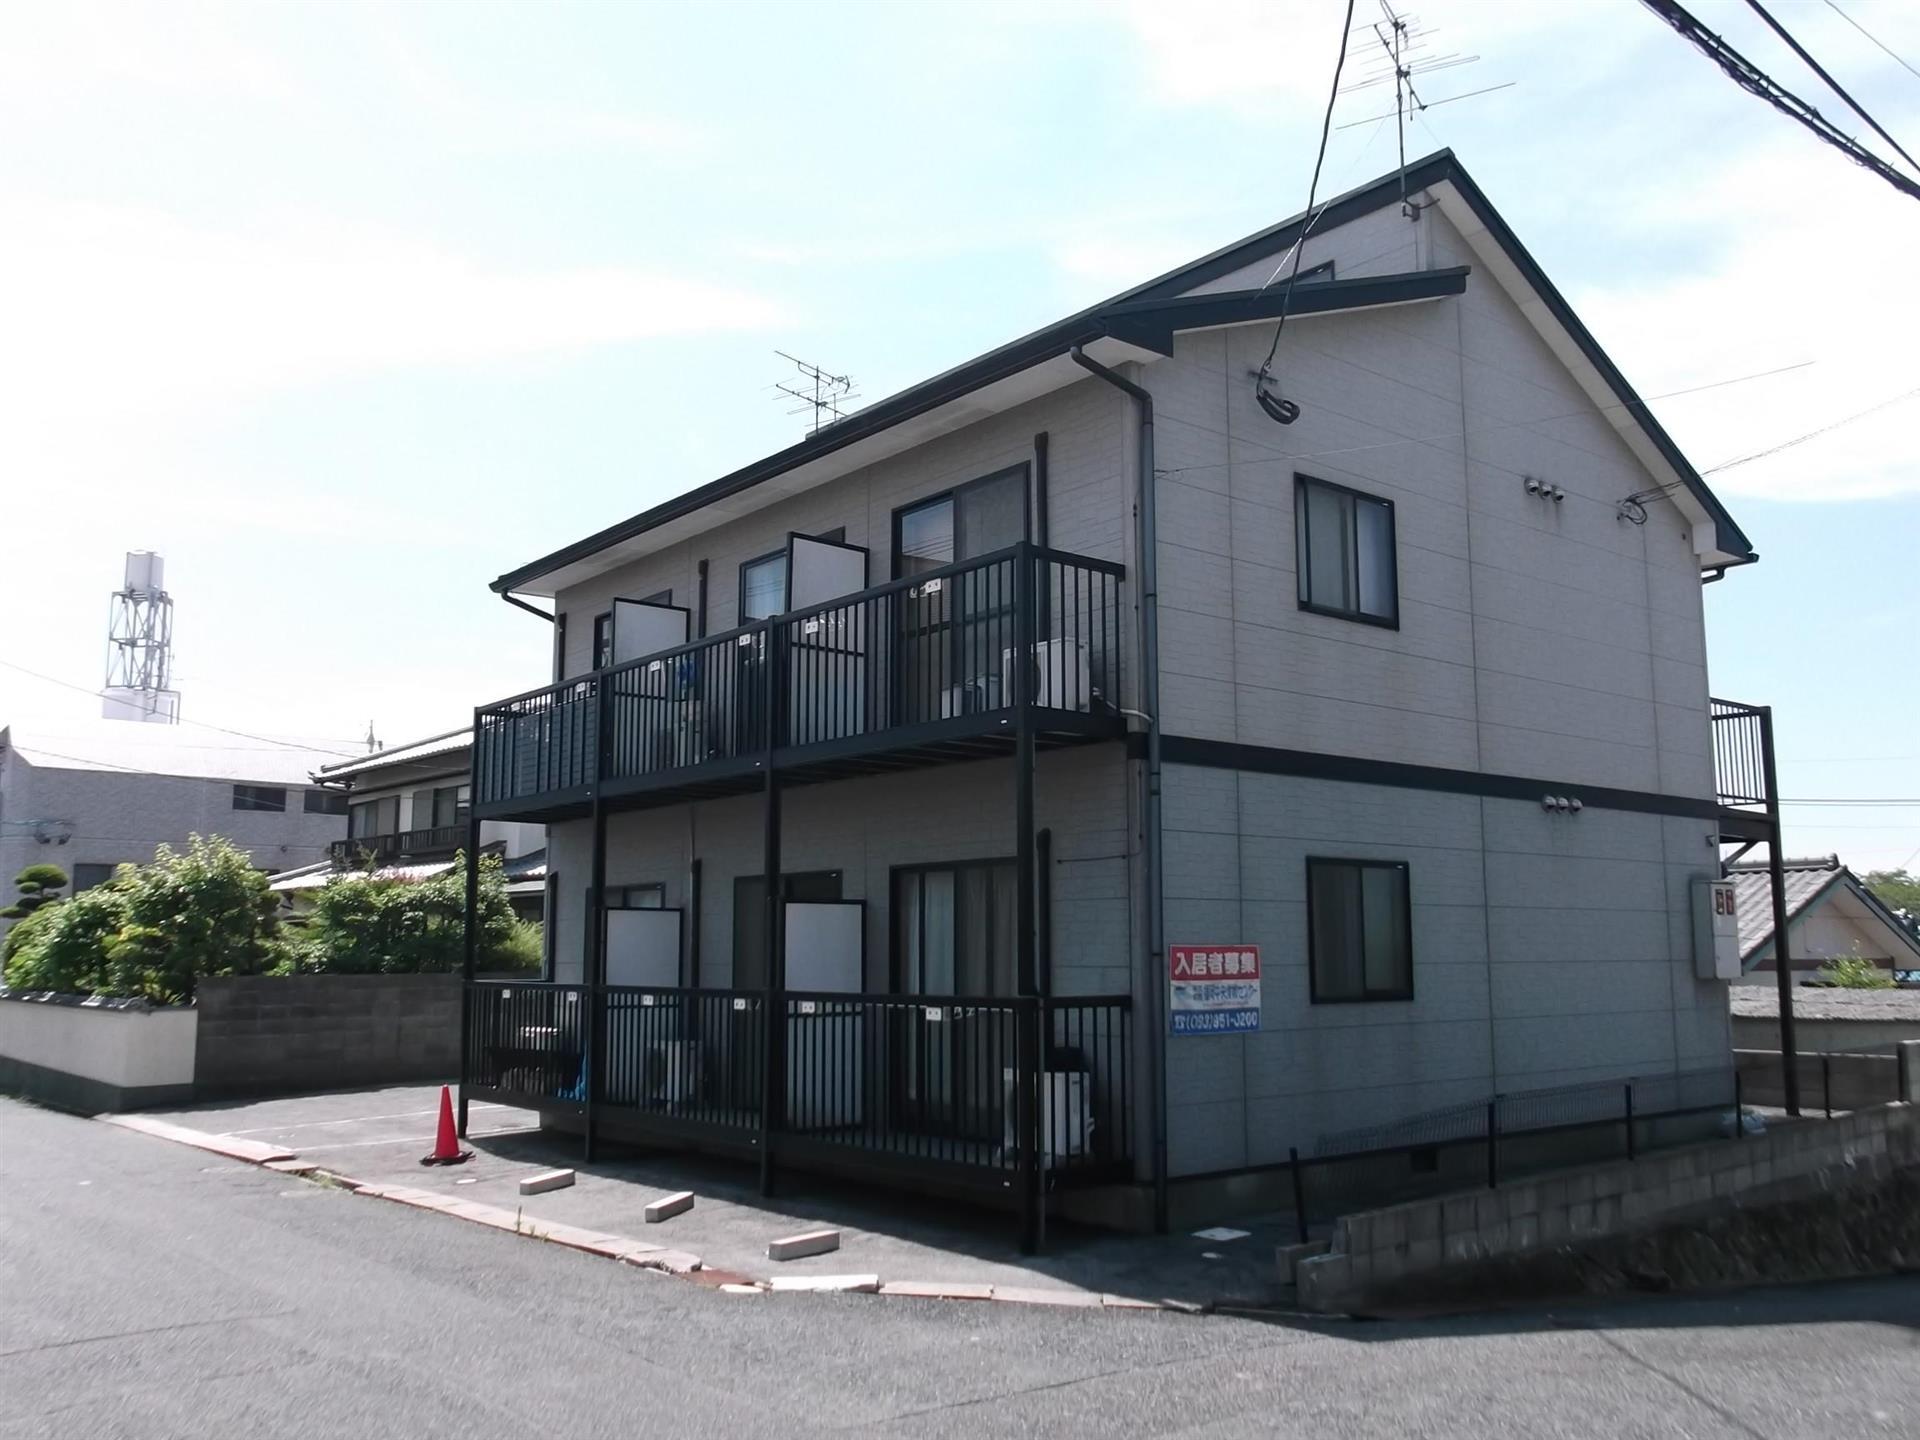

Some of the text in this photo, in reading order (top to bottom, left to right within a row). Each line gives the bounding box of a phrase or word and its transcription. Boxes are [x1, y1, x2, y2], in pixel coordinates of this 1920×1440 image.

[1174, 952, 1256, 976] 入居者募集
